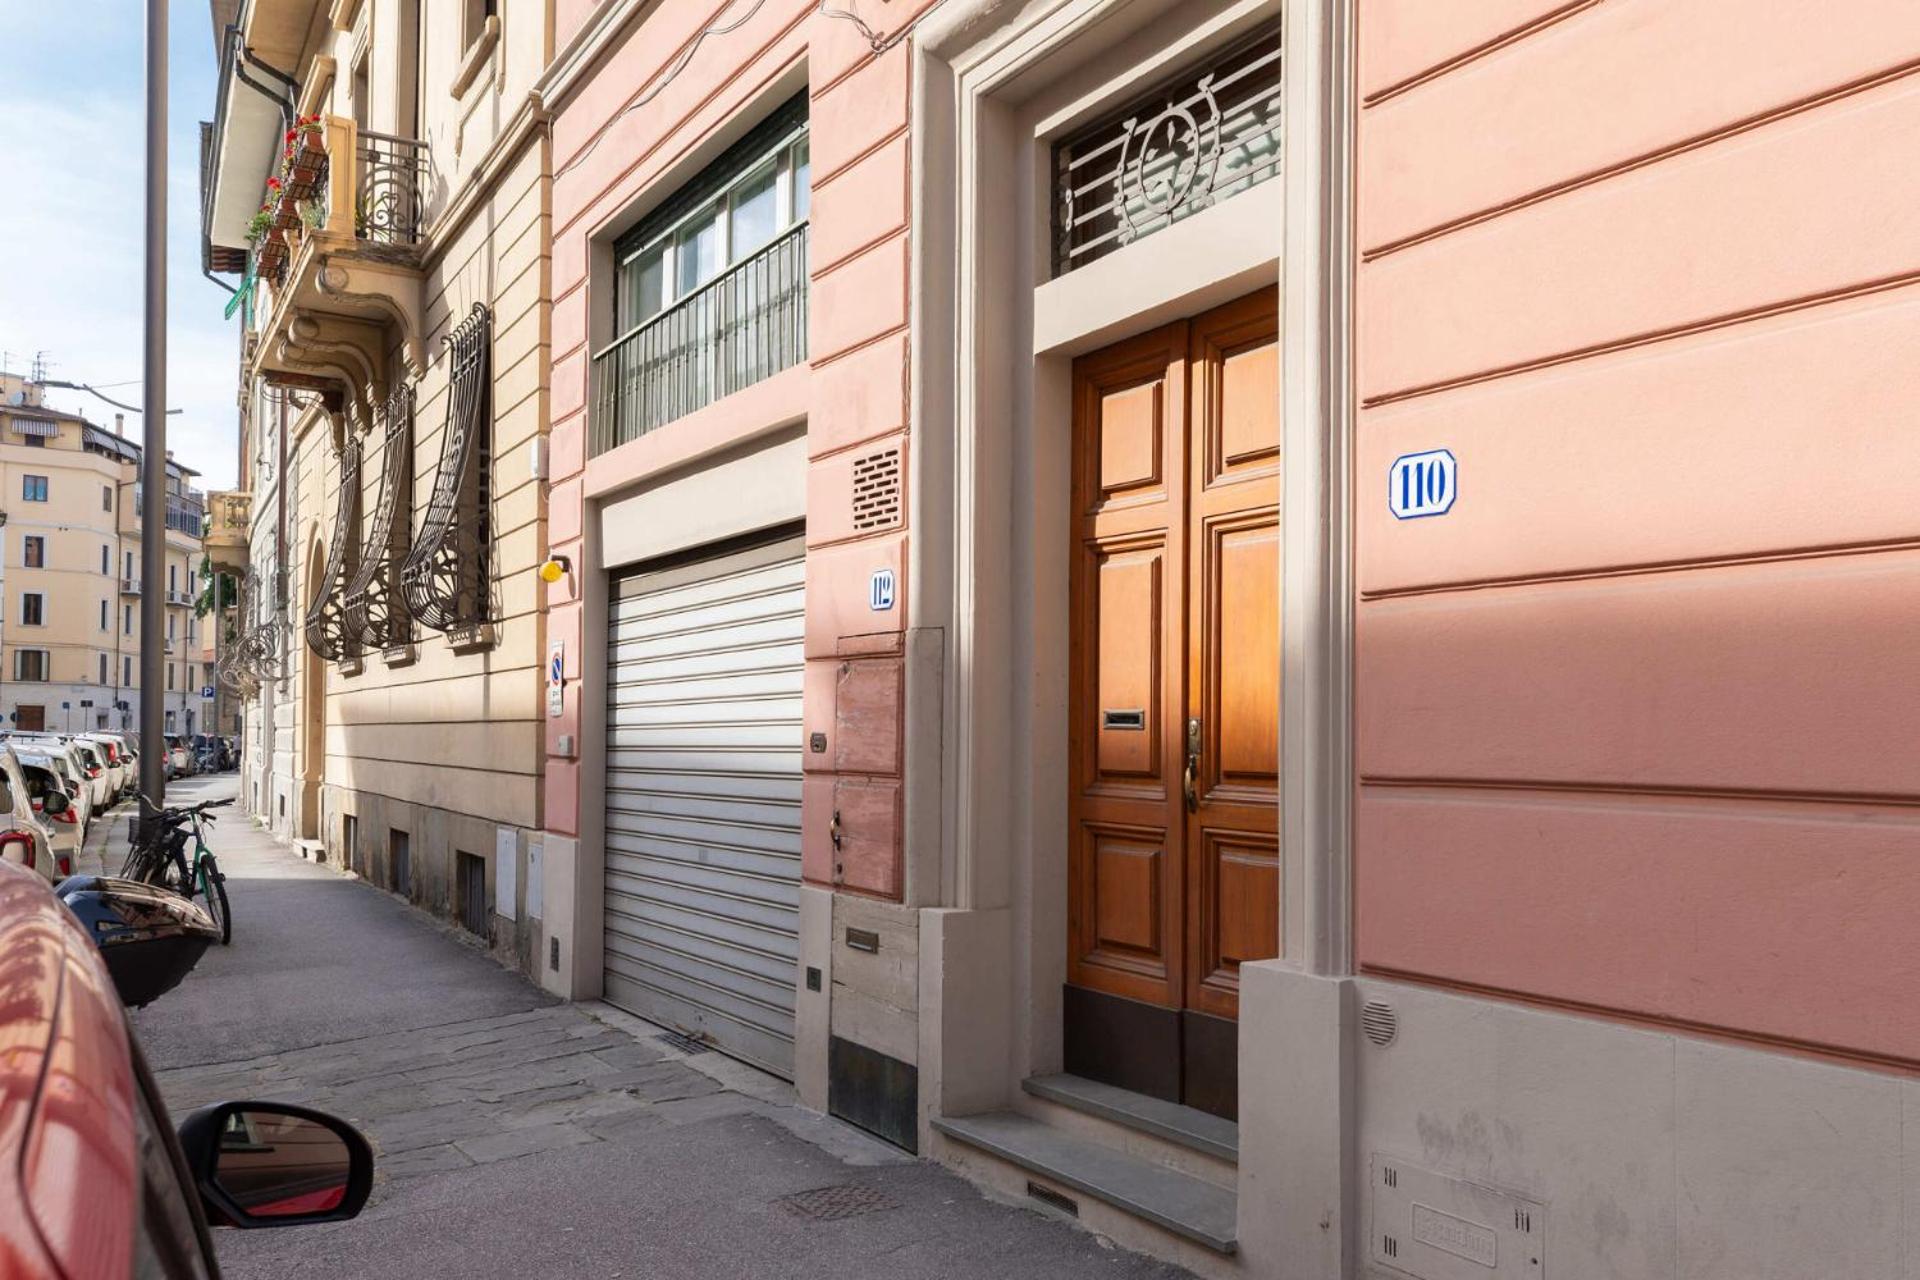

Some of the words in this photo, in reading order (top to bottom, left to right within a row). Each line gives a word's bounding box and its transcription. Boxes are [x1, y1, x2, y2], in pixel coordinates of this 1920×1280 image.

[1401, 460, 1446, 510] 110
[873, 576, 891, 606] 112
[204, 687, 212, 697] P
